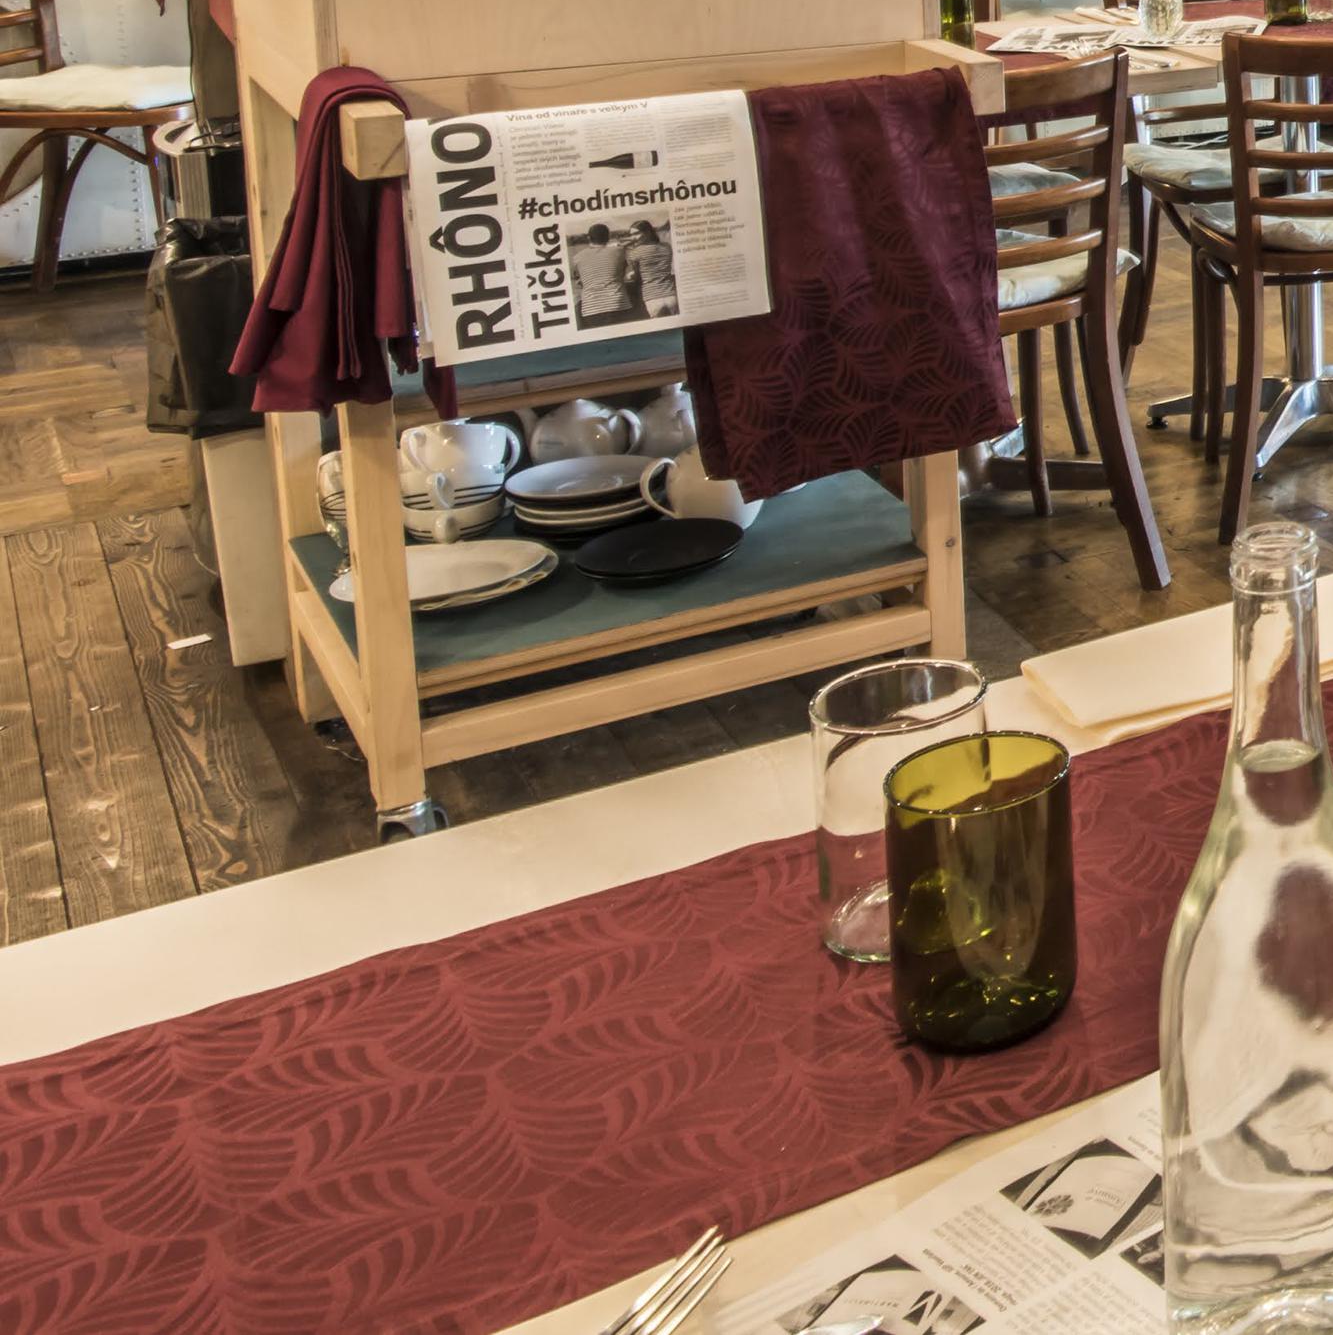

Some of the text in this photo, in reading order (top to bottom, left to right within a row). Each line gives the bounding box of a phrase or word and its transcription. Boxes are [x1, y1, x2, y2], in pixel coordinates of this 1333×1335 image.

[428, 118, 517, 351] RHÔNO
[517, 177, 738, 221] #chodímsrhônou
[523, 222, 571, 340] Trička
